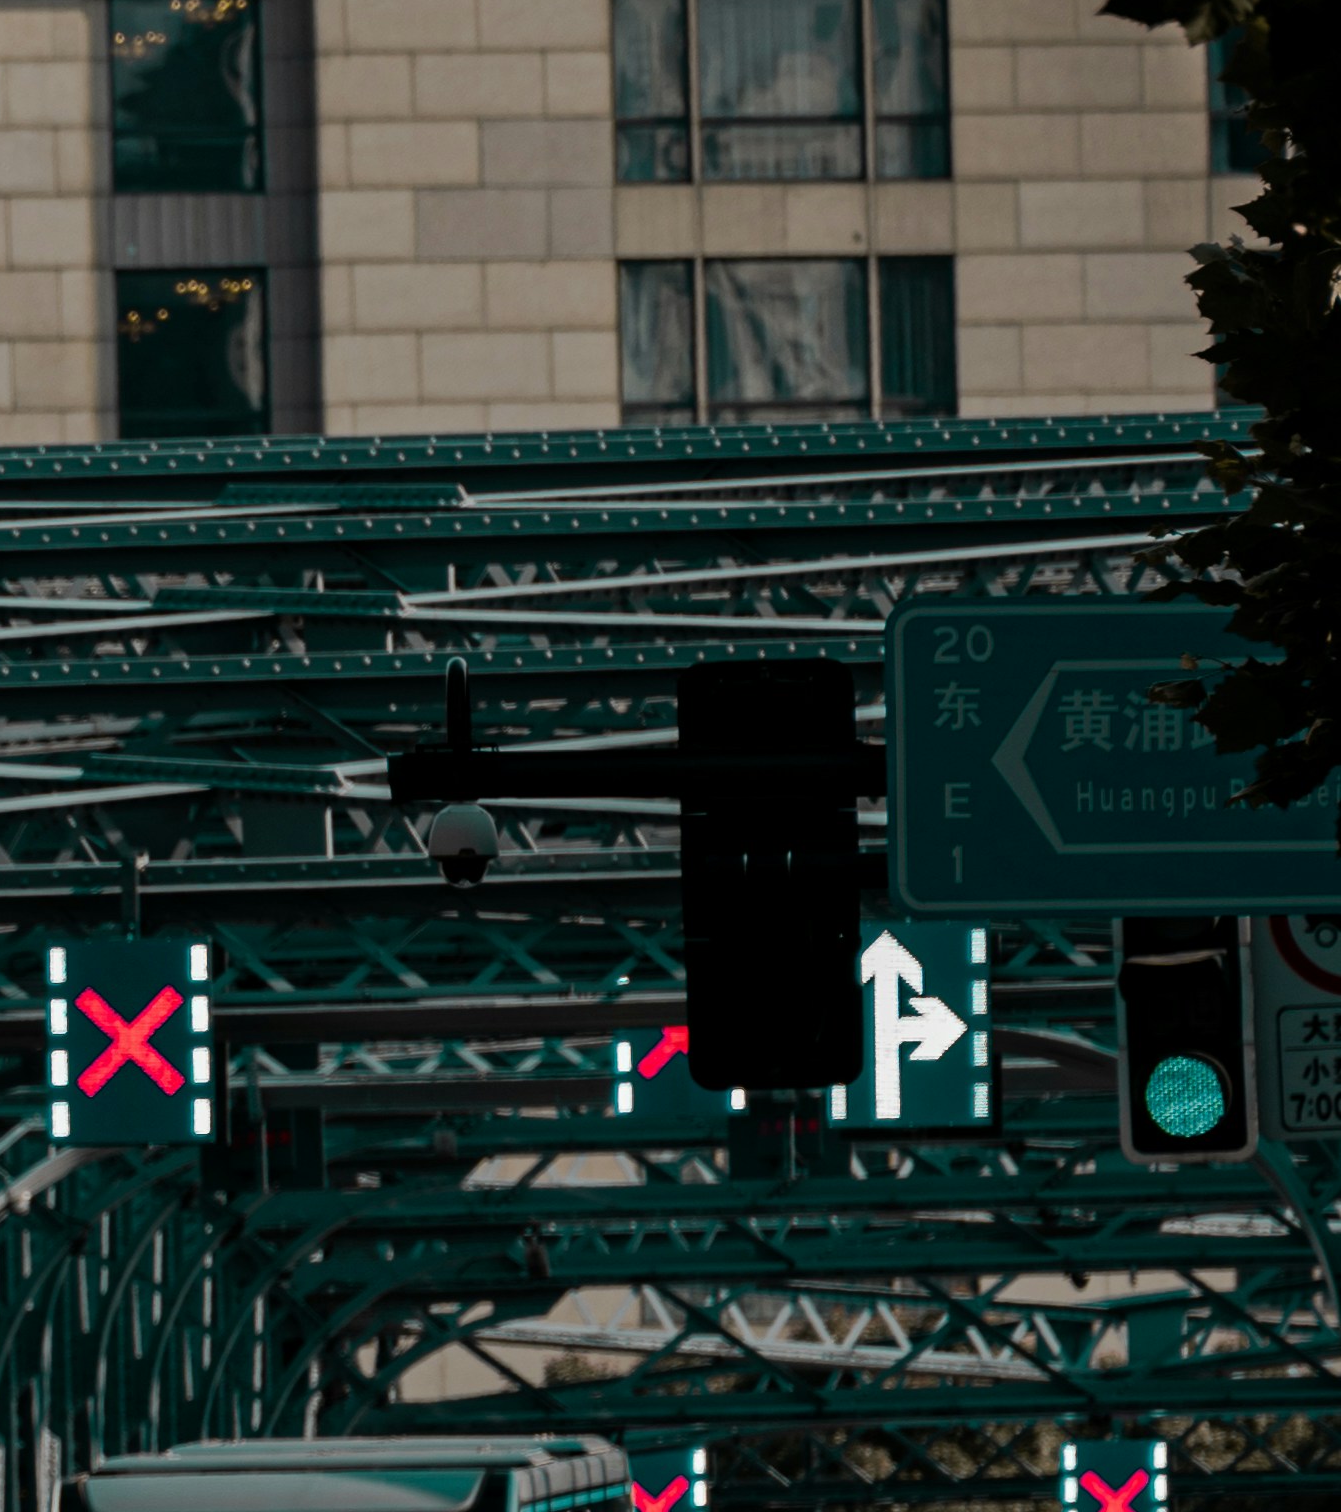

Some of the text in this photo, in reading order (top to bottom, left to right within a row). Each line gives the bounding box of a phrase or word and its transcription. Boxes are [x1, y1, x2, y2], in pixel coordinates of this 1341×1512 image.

[933, 624, 994, 664] 20
[934, 681, 982, 730] 东
[944, 783, 972, 819] E
[1077, 780, 1217, 817] Huangpu
[951, 845, 963, 883] 1
[1303, 1013, 1341, 1043] 大
[1303, 1056, 1341, 1087] 小
